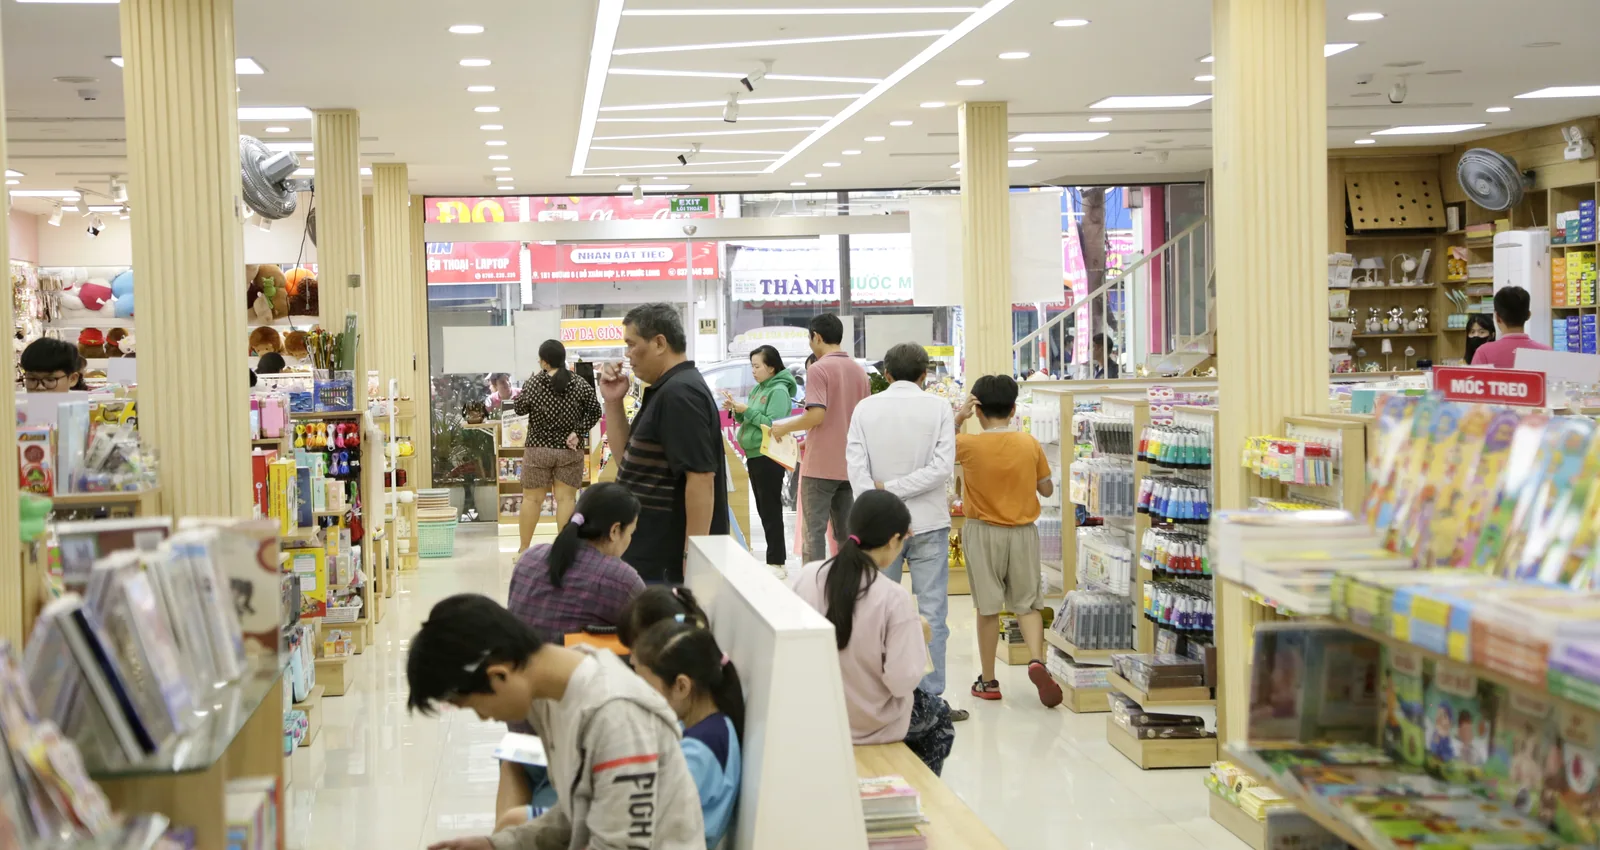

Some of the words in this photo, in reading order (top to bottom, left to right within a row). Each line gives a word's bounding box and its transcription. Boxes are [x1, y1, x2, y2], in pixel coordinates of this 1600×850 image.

[443, 259, 469, 272] THOẠI
[475, 258, 510, 270] LAPTOP
[759, 273, 835, 296] THÀNH
[580, 327, 594, 340] DA
[1451, 375, 1485, 395] MÓC
[1487, 380, 1528, 398] TREO
